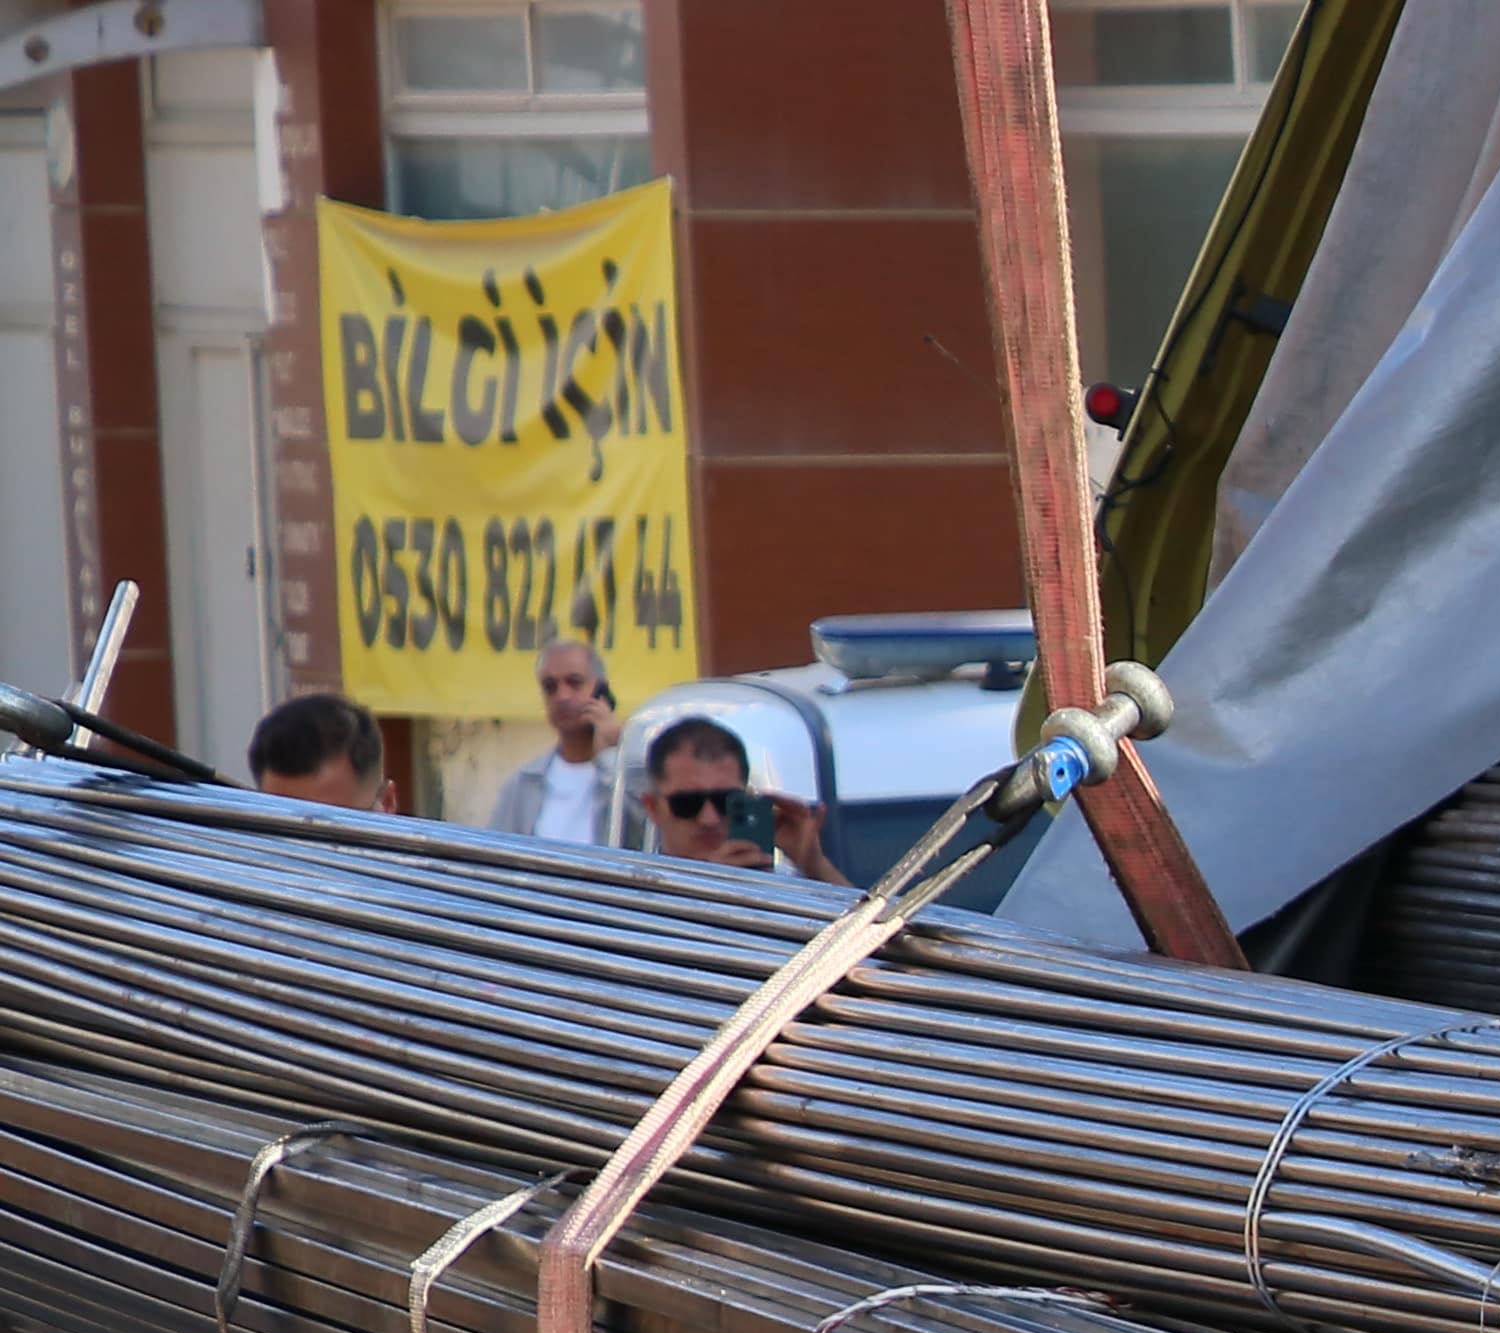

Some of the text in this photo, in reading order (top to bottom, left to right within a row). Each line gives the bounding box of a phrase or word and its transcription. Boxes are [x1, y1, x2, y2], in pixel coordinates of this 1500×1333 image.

[340, 258, 673, 482] BİLGİ İÇİN
[352, 514, 467, 651] 0530
[484, 515, 558, 651] 822
[634, 514, 683, 650] 44
